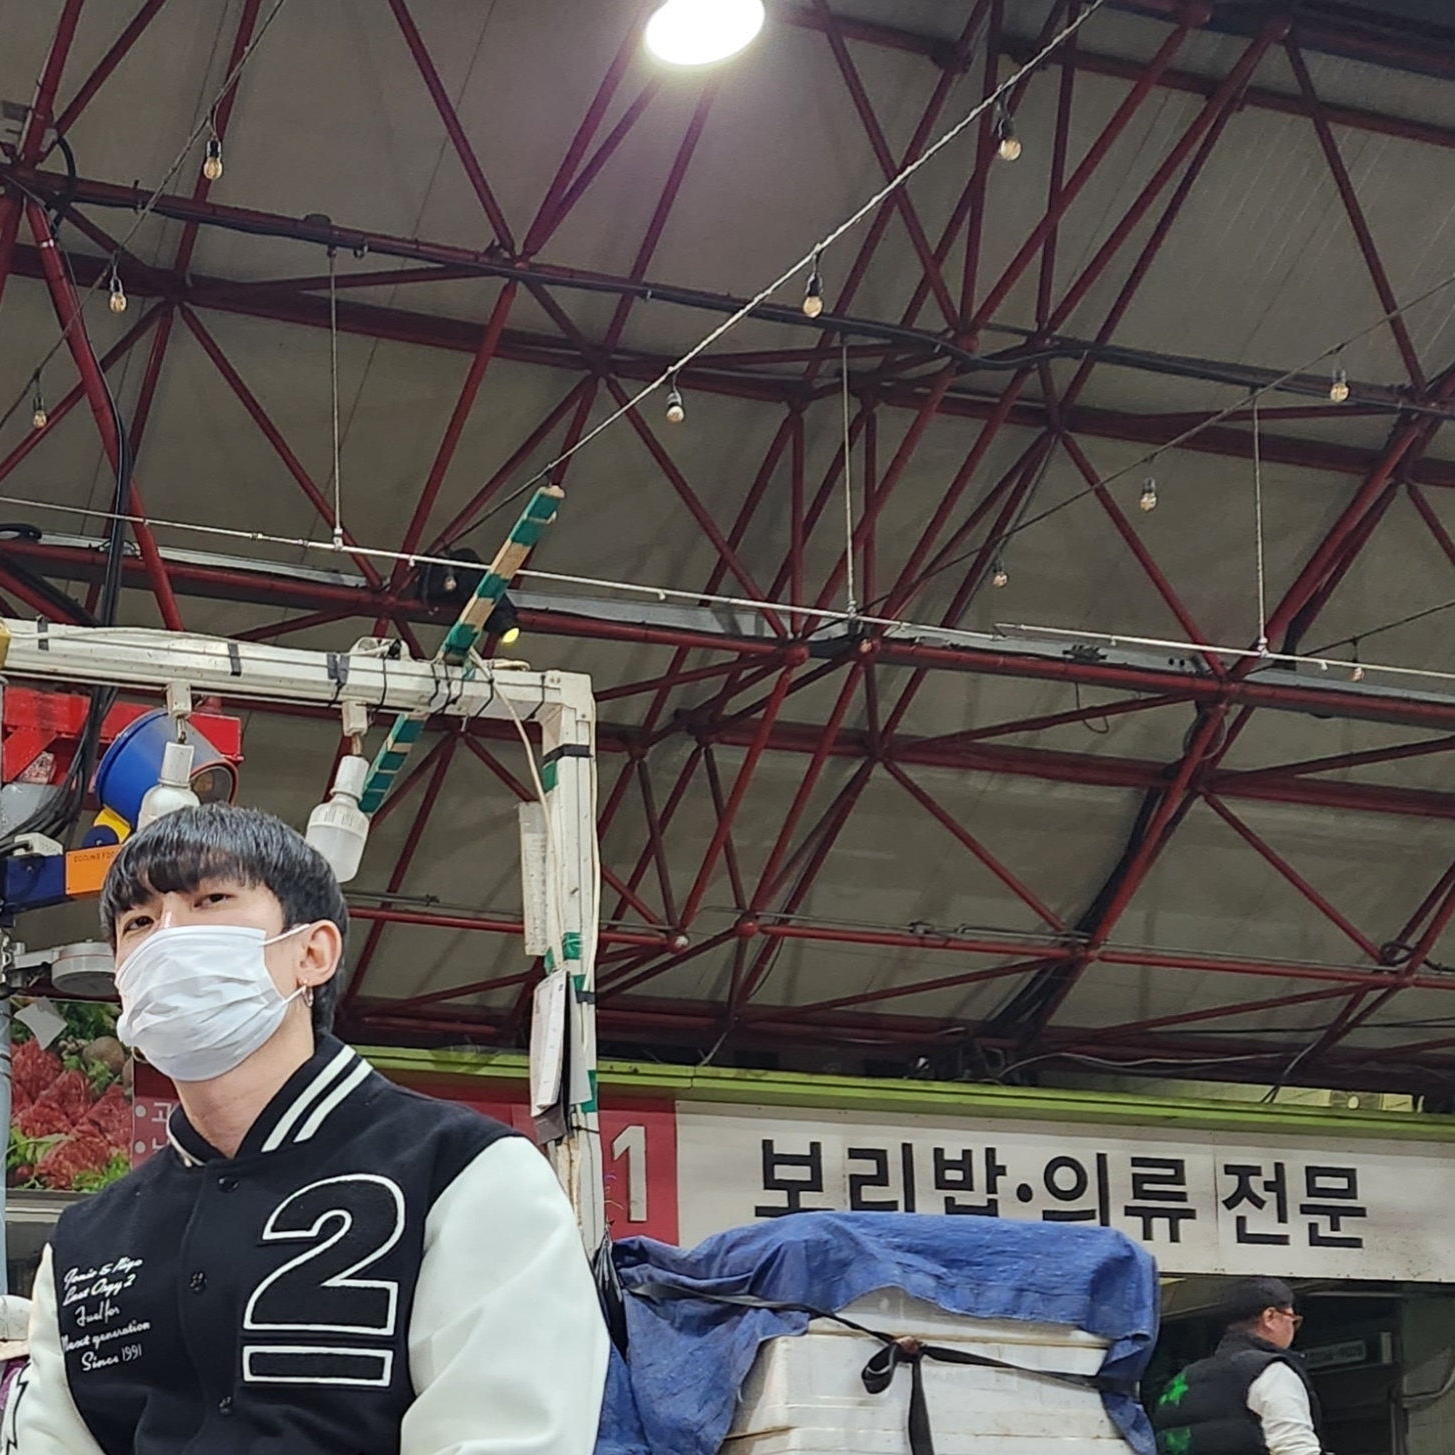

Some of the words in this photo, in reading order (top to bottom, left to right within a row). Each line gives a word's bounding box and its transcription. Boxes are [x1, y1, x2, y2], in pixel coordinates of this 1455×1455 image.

[611, 1125, 648, 1223] 1
[753, 1138, 1198, 1244] 보리밥·의류
[1221, 1160, 1367, 1249] 전문
[243, 1172, 407, 1337] 2
[81, 1350, 119, 1371] Since
[120, 1342, 143, 1361] 1991
[91, 1319, 151, 1351] generation
